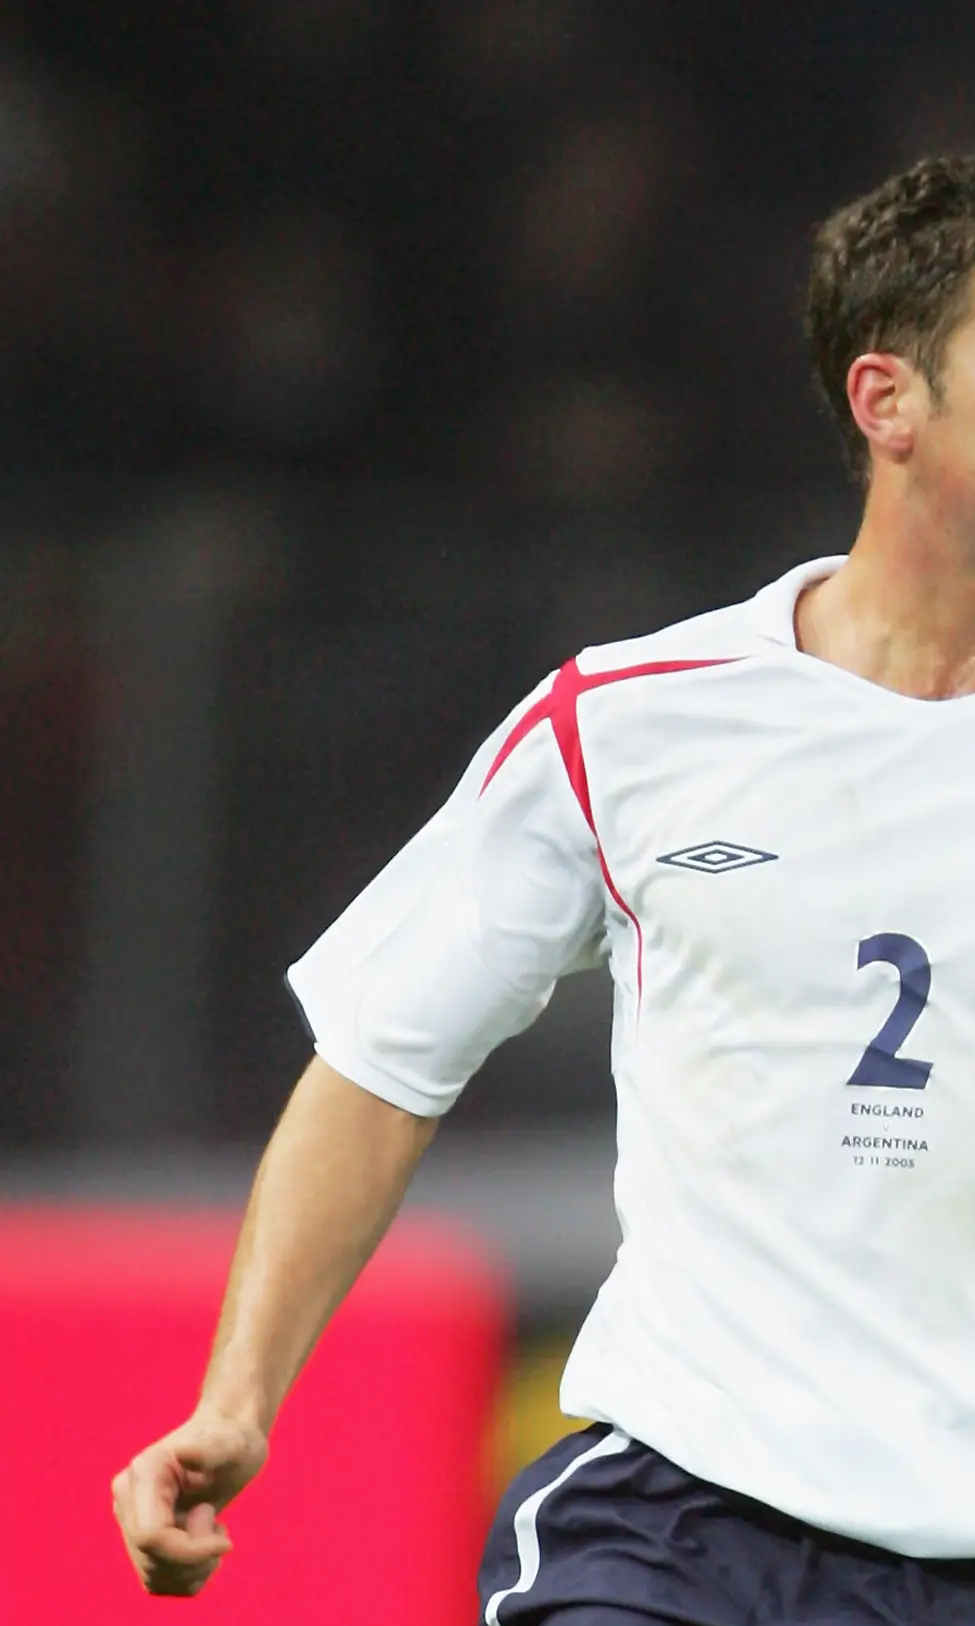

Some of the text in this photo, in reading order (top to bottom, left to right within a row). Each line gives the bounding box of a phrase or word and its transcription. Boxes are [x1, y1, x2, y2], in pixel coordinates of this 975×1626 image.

[847, 932, 933, 1089] 2
[851, 1103, 924, 1118] ENGLAND
[841, 1136, 929, 1150] ARGENTINA
